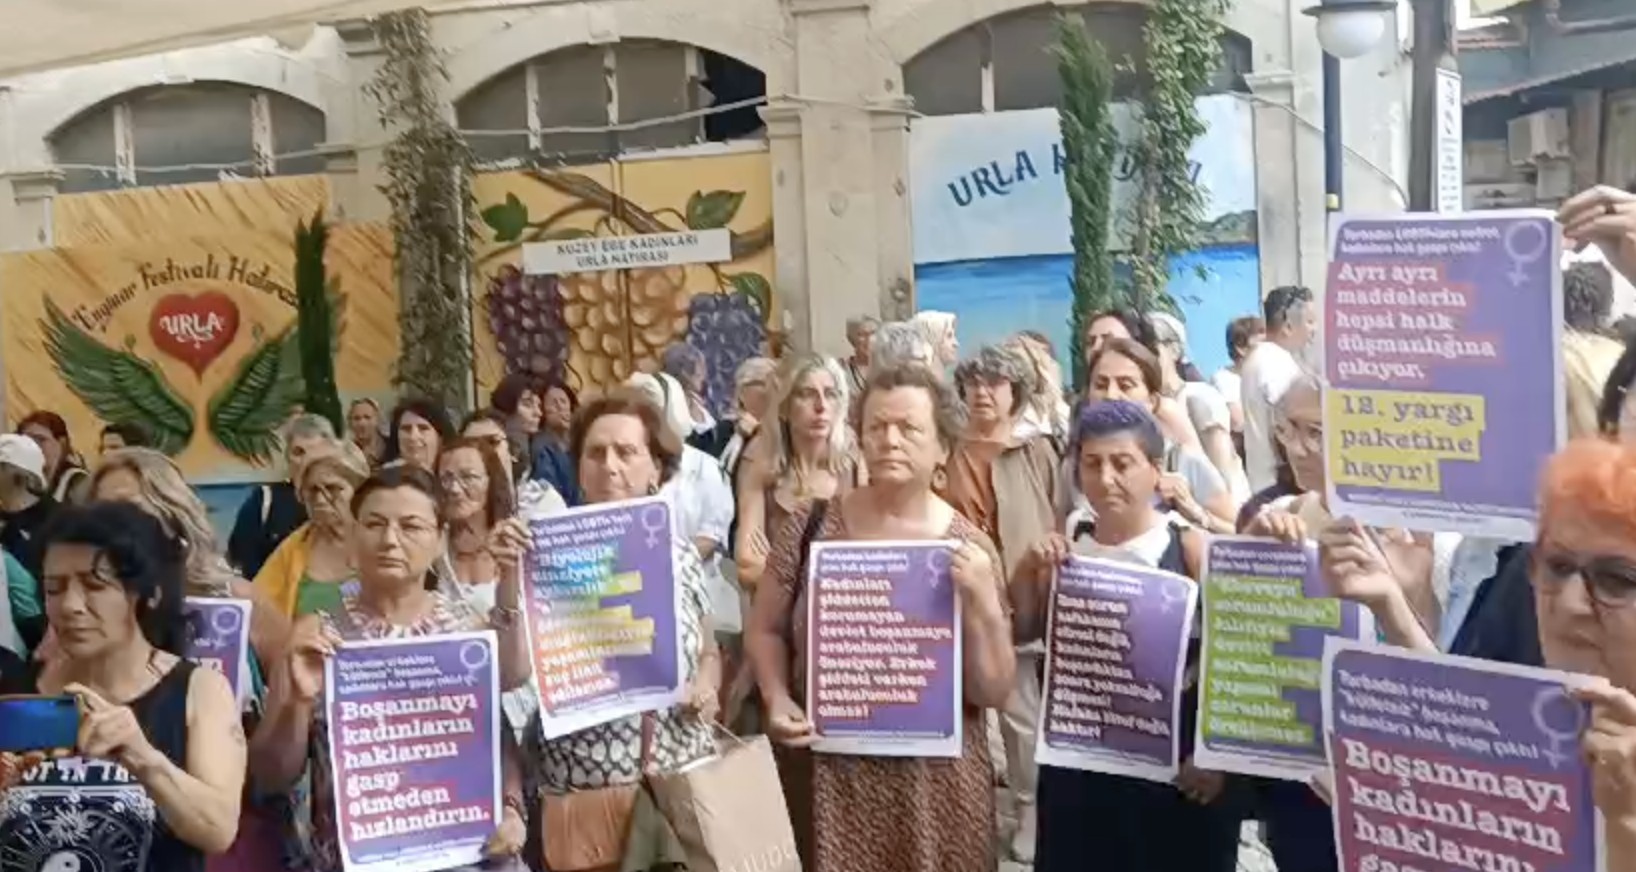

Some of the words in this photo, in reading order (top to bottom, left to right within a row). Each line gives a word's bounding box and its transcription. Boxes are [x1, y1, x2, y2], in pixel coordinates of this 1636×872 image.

[947, 150, 1038, 207] URLA
[138, 254, 219, 290] Festivali
[576, 252, 609, 268] URLA
[1337, 263, 1385, 285] Ayrı
[1391, 264, 1438, 285] ayrı
[1336, 289, 1467, 307] maddelerin
[160, 311, 224, 337] URLA
[1335, 311, 1395, 330] hepsi
[1400, 313, 1454, 331] halk
[1336, 333, 1496, 358] düşmanlığına
[1342, 394, 1386, 416] 12.
[1393, 400, 1474, 427] yargı
[1340, 428, 1473, 452] paketine
[1341, 455, 1434, 482] hayır!
[819, 610, 905, 623] korumayan
[819, 625, 867, 638] devlet
[874, 674, 928, 687] varken
[340, 694, 479, 722] Boşanmayı
[343, 717, 474, 746] kadınların
[343, 740, 458, 769] haklarını
[345, 771, 401, 797] gasp
[1341, 737, 1571, 814] Boşanmayı
[349, 787, 451, 817] etmeden
[351, 806, 491, 842] hızlandırın.
[1346, 776, 1564, 855] kadınların
